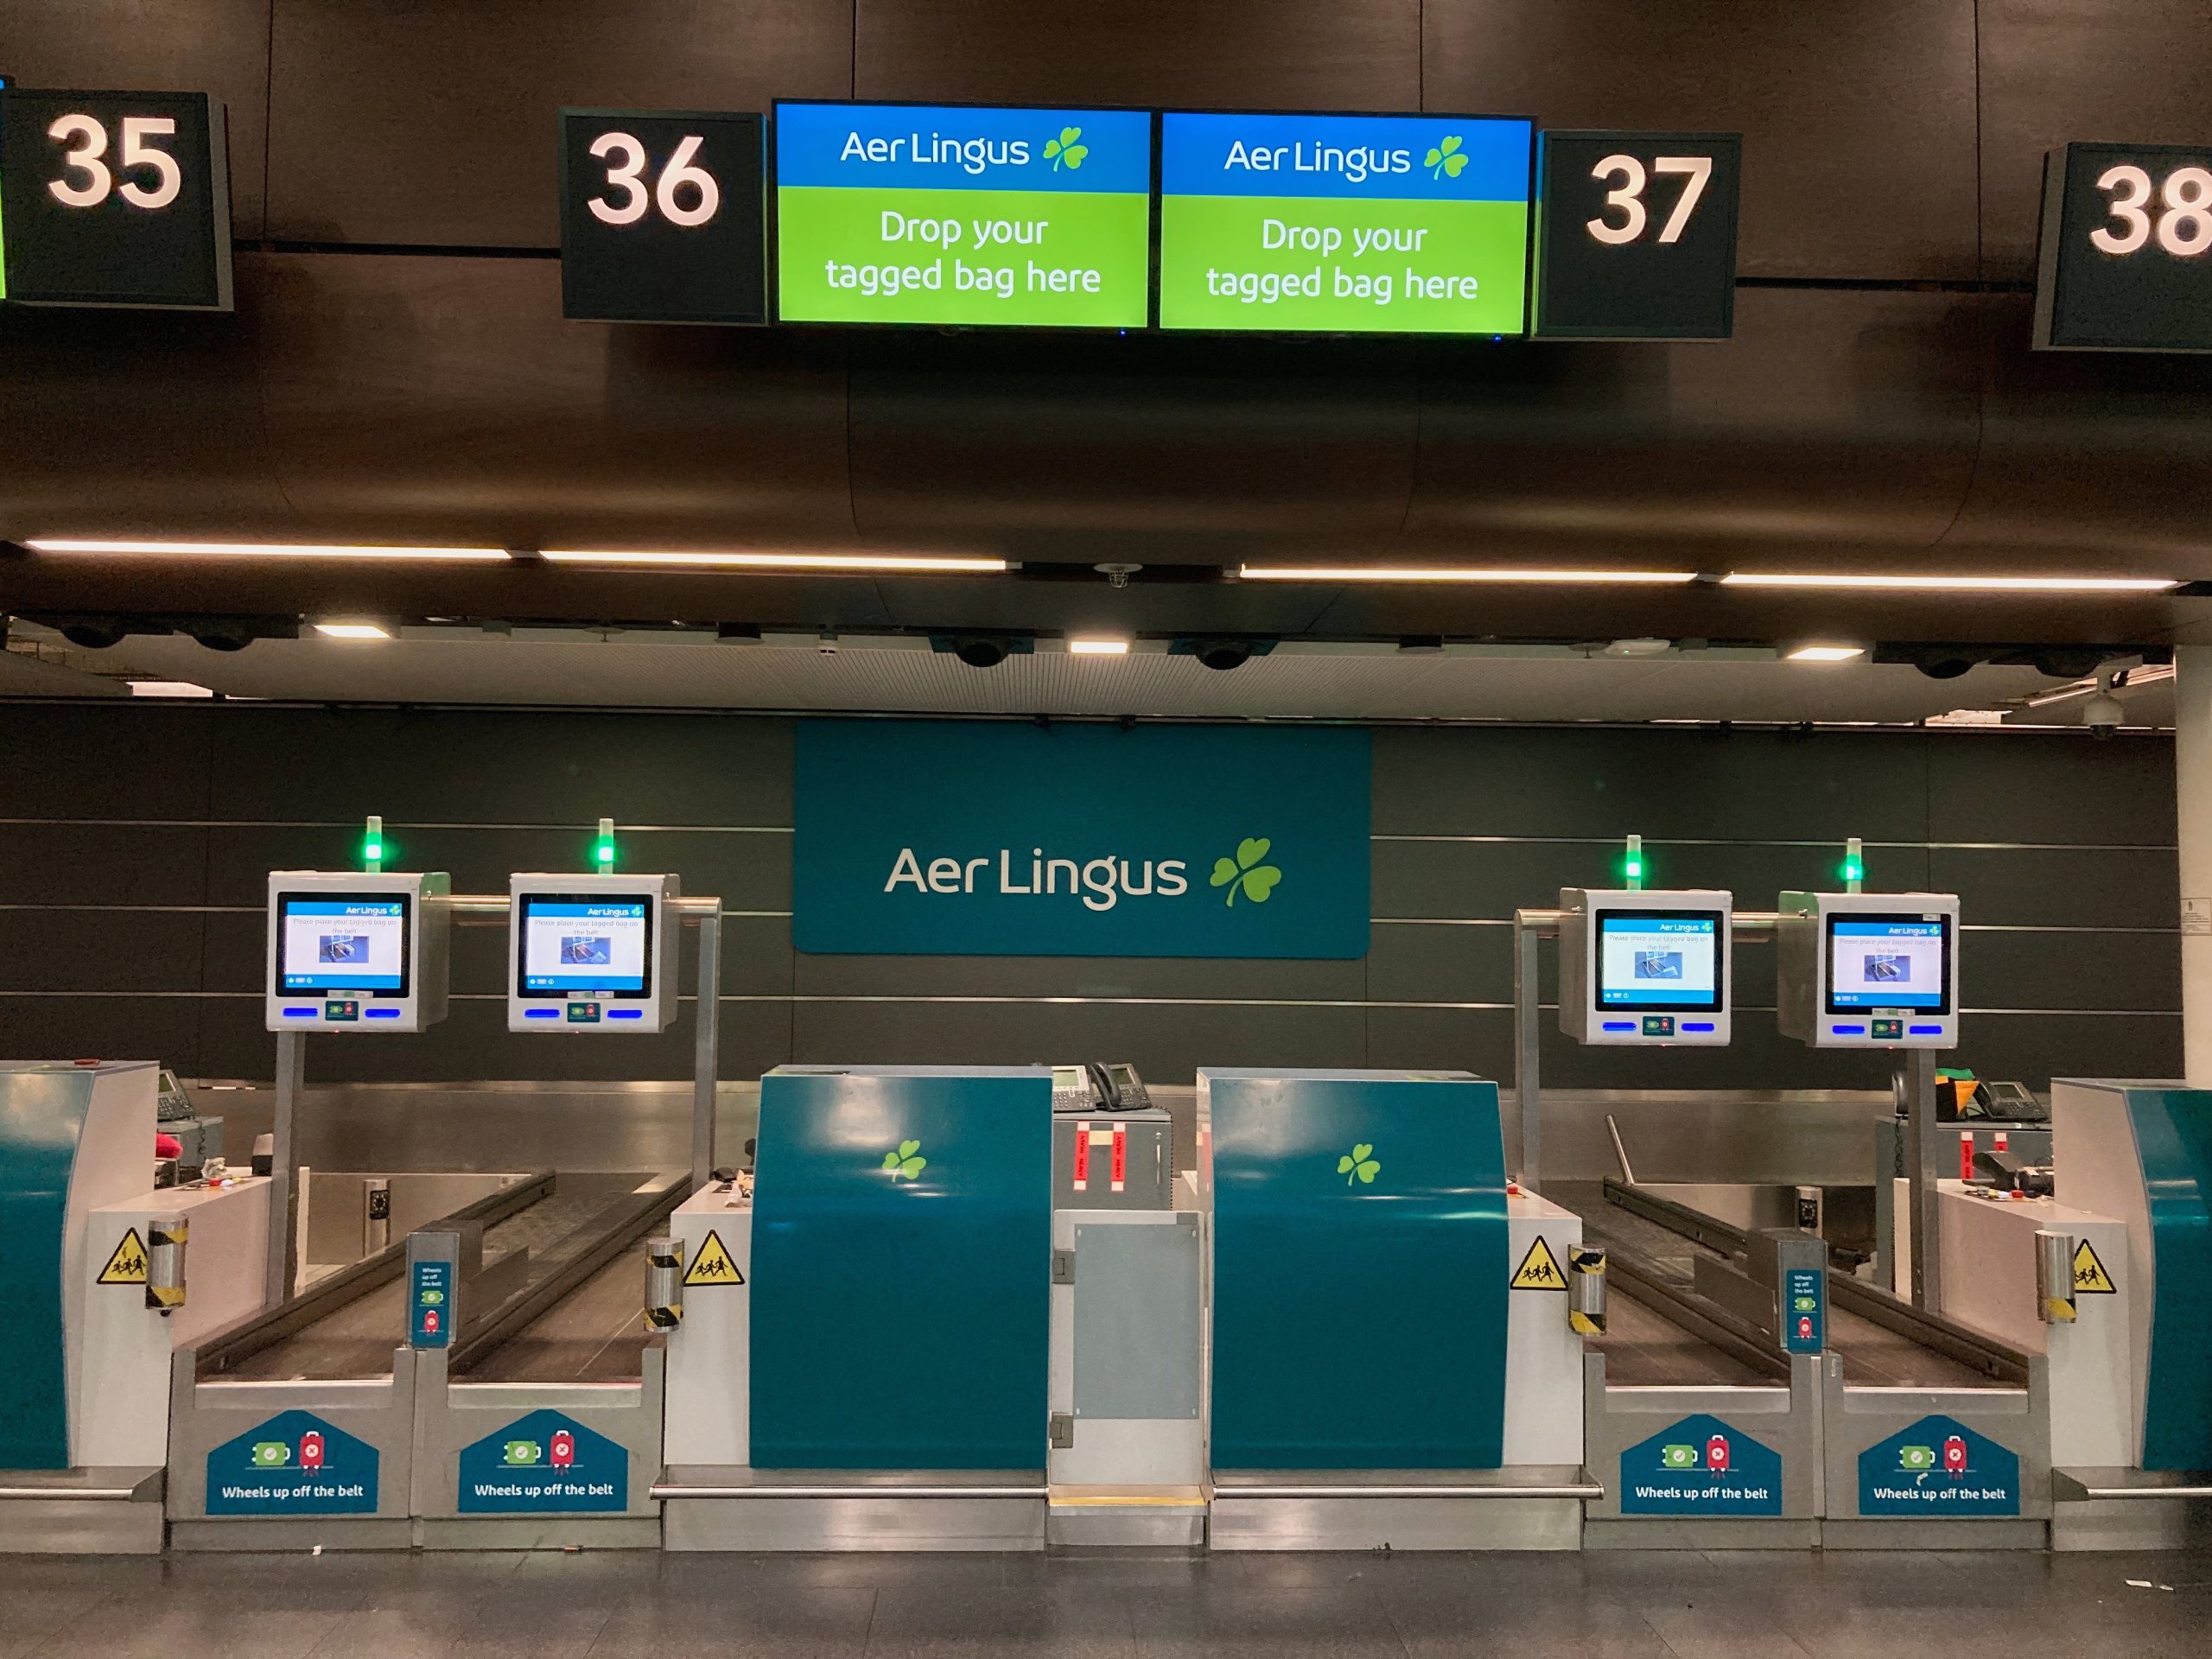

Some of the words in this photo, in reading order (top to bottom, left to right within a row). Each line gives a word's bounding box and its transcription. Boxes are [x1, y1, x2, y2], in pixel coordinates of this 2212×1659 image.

[49, 115, 181, 207] 35
[841, 132, 905, 162] Aer
[912, 133, 1030, 175] Lingus
[1224, 141, 1289, 170] Aer
[1295, 142, 1411, 183] Lingus
[588, 133, 719, 226] 36
[1587, 155, 1713, 245] 37
[881, 210, 962, 250] Drop
[972, 219, 1049, 250] your
[2091, 166, 2212, 255] 38
[1262, 219, 1342, 257] Drop
[1353, 227, 1428, 257] your
[824, 258, 942, 296] tagged
[955, 258, 1014, 299] bag
[1028, 259, 1101, 293] here
[1205, 265, 1321, 304] tagged
[1333, 265, 1393, 306] bag
[1405, 267, 1478, 300] here
[884, 848, 989, 893] Aer
[1000, 848, 1188, 912] Lingus
[603, 908, 629, 917] Lingus
[1903, 927, 1927, 936] Lingus
[222, 1486, 270, 1498] Wheels
[273, 1488, 289, 1500] up
[292, 1485, 312, 1497] off
[314, 1485, 335, 1497] the
[338, 1484, 364, 1497] belt
[474, 1484, 522, 1497] Wheels
[524, 1486, 541, 1498] up
[543, 1483, 563, 1496] off
[564, 1484, 586, 1496] the
[588, 1483, 614, 1496] belt
[1635, 1486, 1681, 1498] Wheels
[1683, 1489, 1699, 1501] up
[1701, 1486, 1719, 1498] off
[1721, 1487, 1742, 1499] the
[1744, 1487, 1769, 1499] belt
[1873, 1487, 1919, 1500] Wheels
[1922, 1490, 1937, 1502] up
[1939, 1487, 1957, 1499] off
[1959, 1488, 1980, 1500] the
[1982, 1488, 2006, 1500] belt
